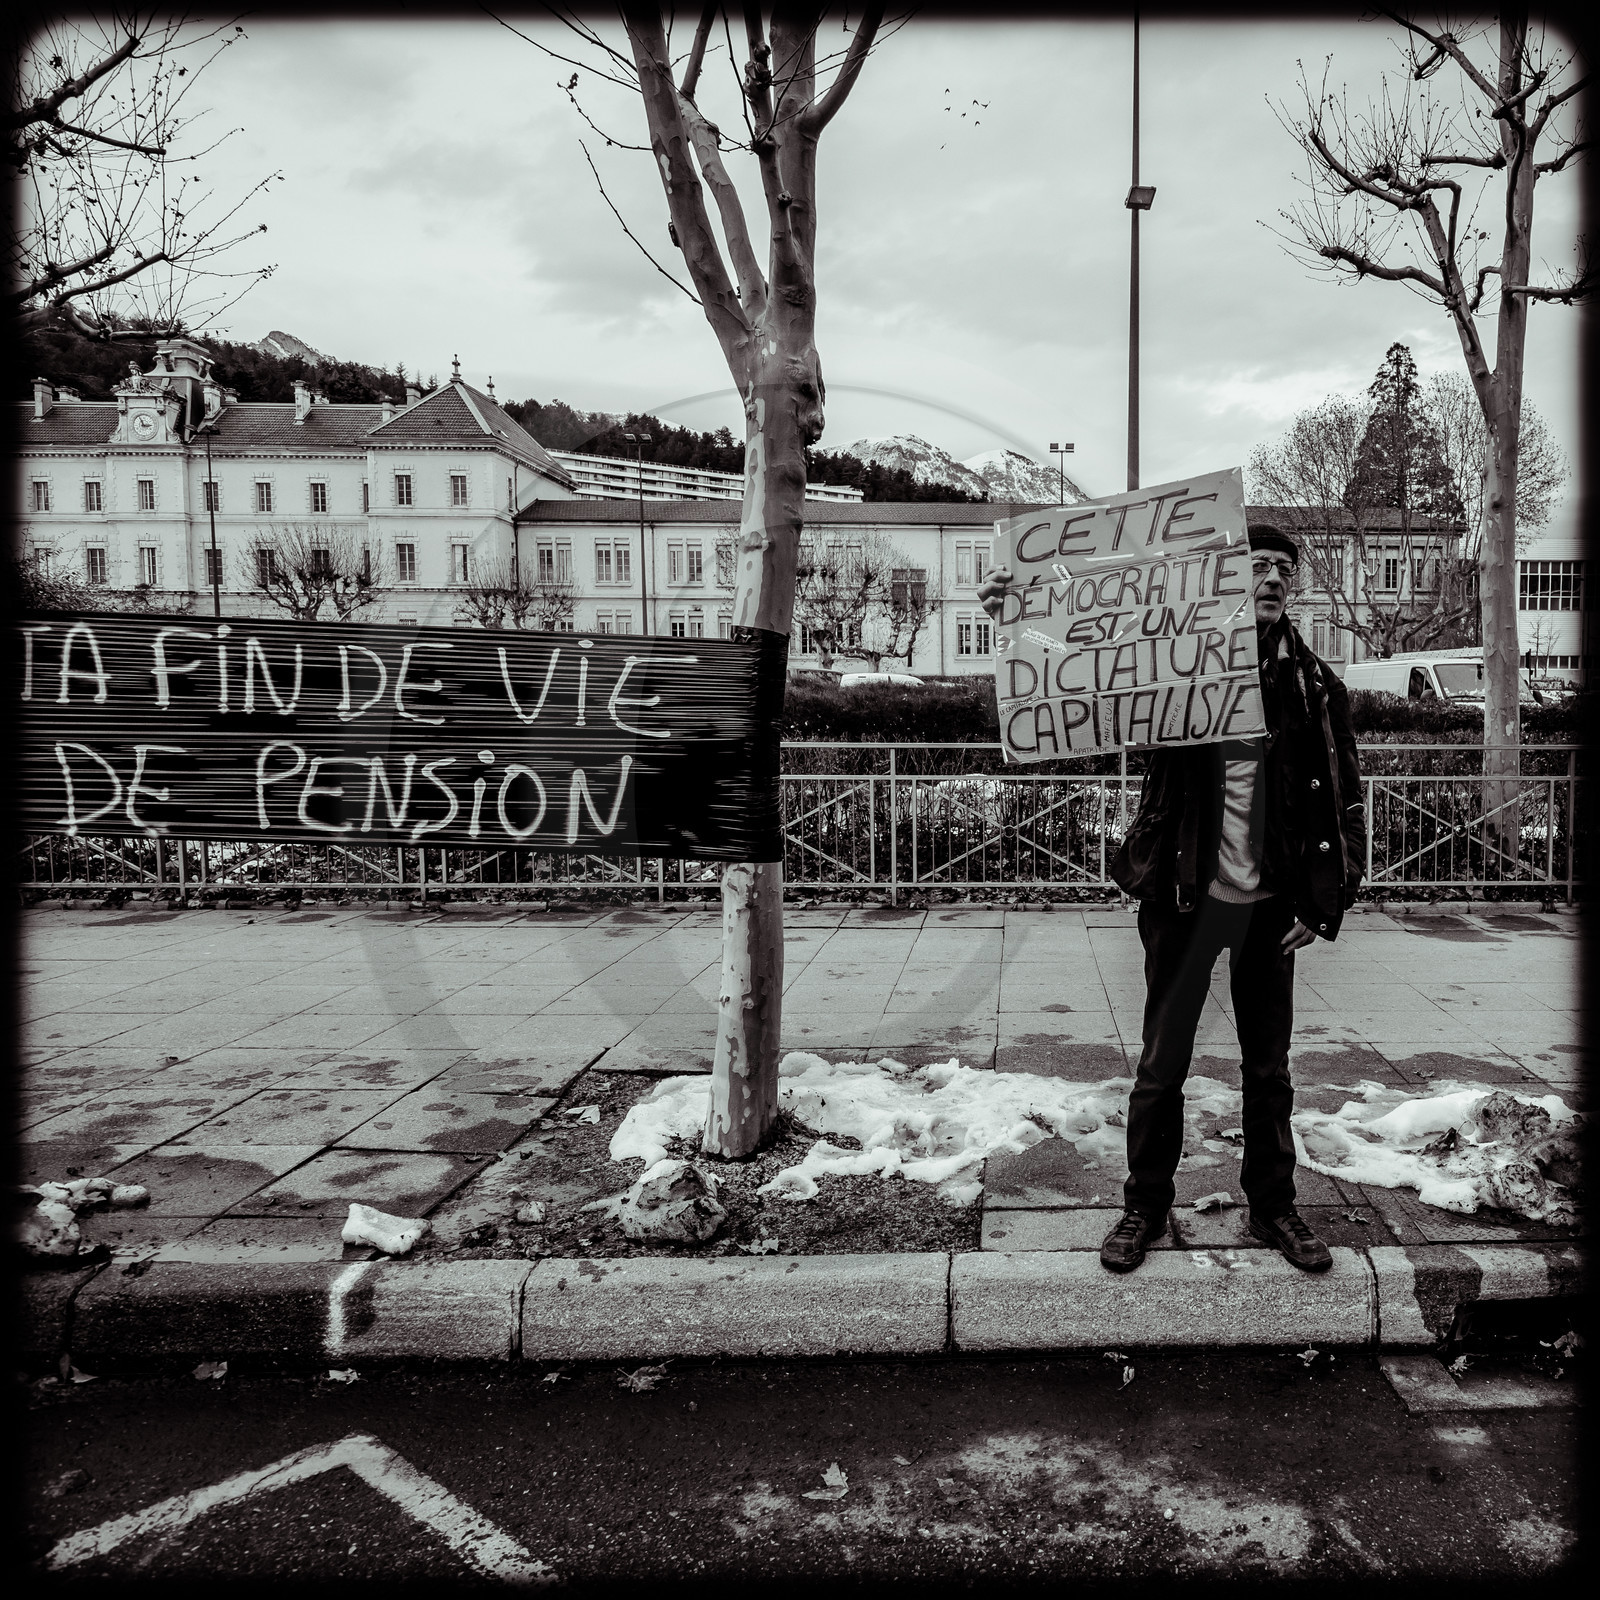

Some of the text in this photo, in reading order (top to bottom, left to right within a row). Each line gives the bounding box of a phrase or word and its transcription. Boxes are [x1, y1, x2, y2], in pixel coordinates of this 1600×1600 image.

[1016, 488, 1219, 563] CETTE
[1065, 600, 1221, 645] EST UNE
[336, 642, 454, 725] DE
[55, 741, 188, 838] DE
